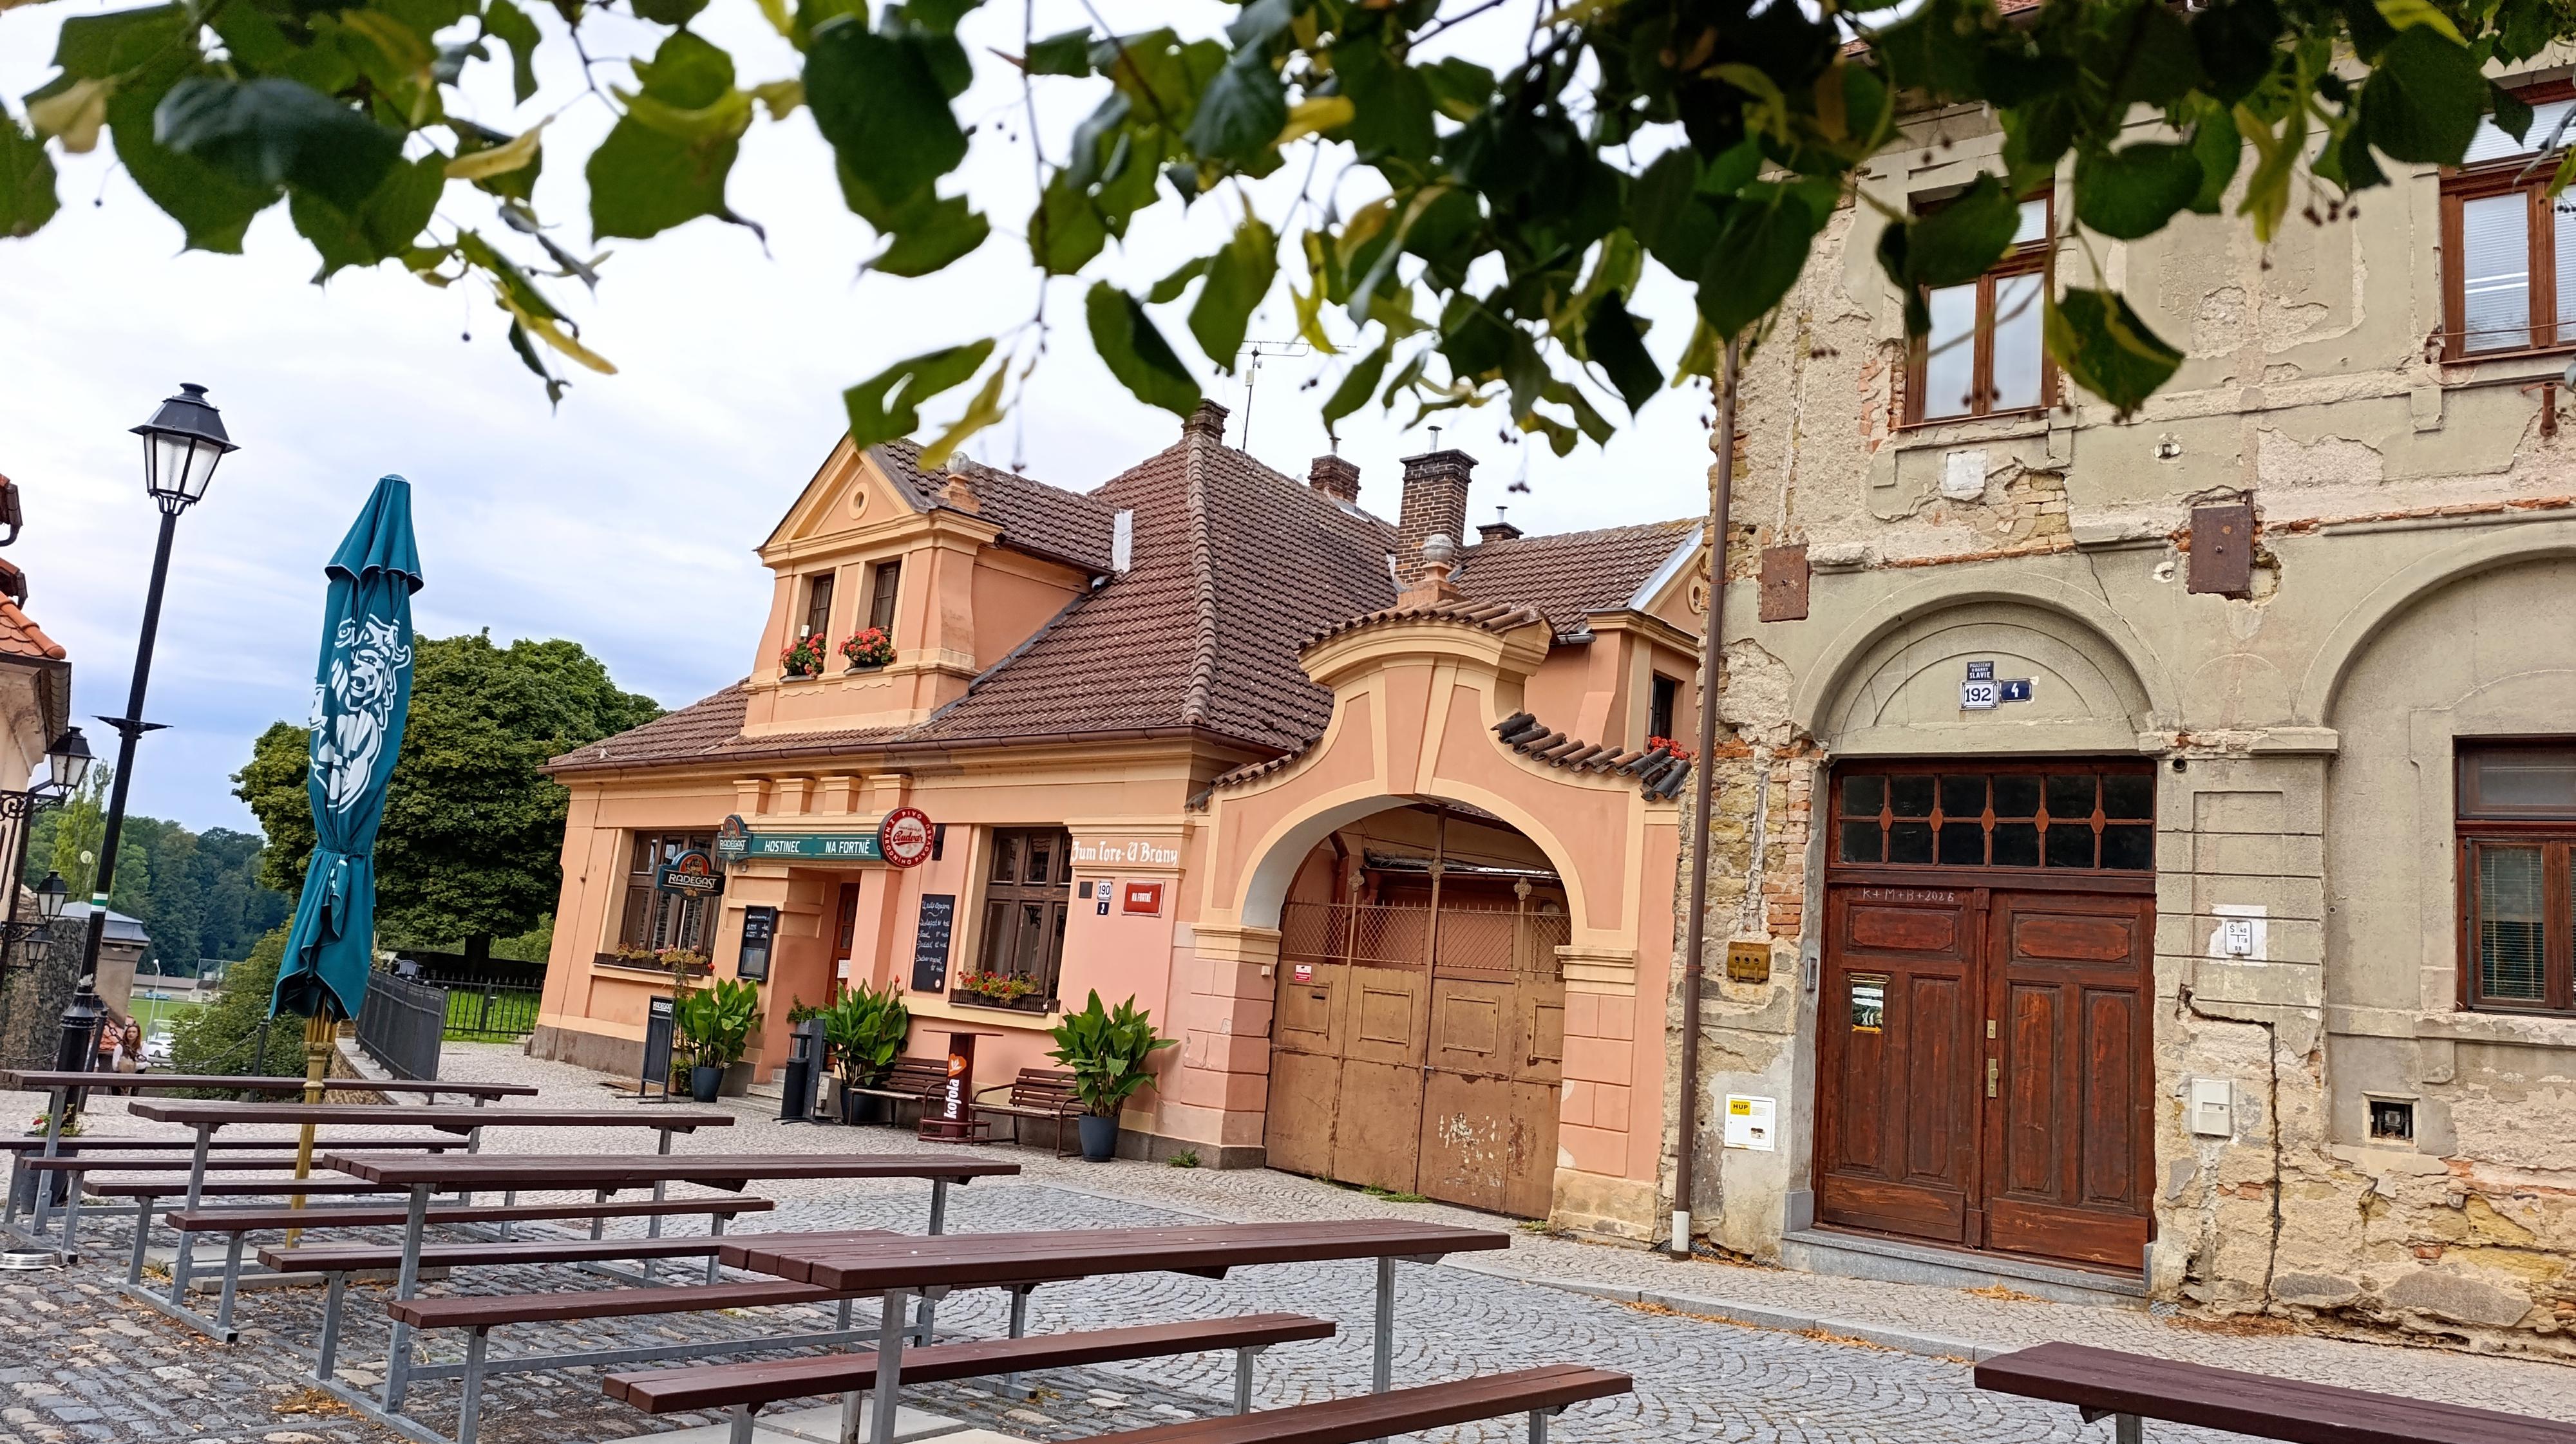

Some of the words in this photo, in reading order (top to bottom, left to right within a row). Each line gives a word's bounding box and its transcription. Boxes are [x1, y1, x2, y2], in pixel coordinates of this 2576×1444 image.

[1965, 688, 1991, 702] 192
[2011, 683, 2019, 698] 4
[719, 839, 746, 851] RADEGAST
[893, 830, 923, 845] Budvar
[914, 824, 932, 863] PIVOVARU
[764, 840, 800, 853] HOSTINEC
[826, 841, 837, 854] NA
[838, 839, 870, 854] FORTNĚ
[1071, 841, 1096, 863] Zum
[1140, 842, 1178, 867] Brány
[668, 874, 717, 889] RADEGAST
[1099, 885, 1110, 895] 190
[1100, 903, 1105, 914] 2
[2230, 924, 2235, 933] Š
[943, 1078, 962, 1119] kofola
